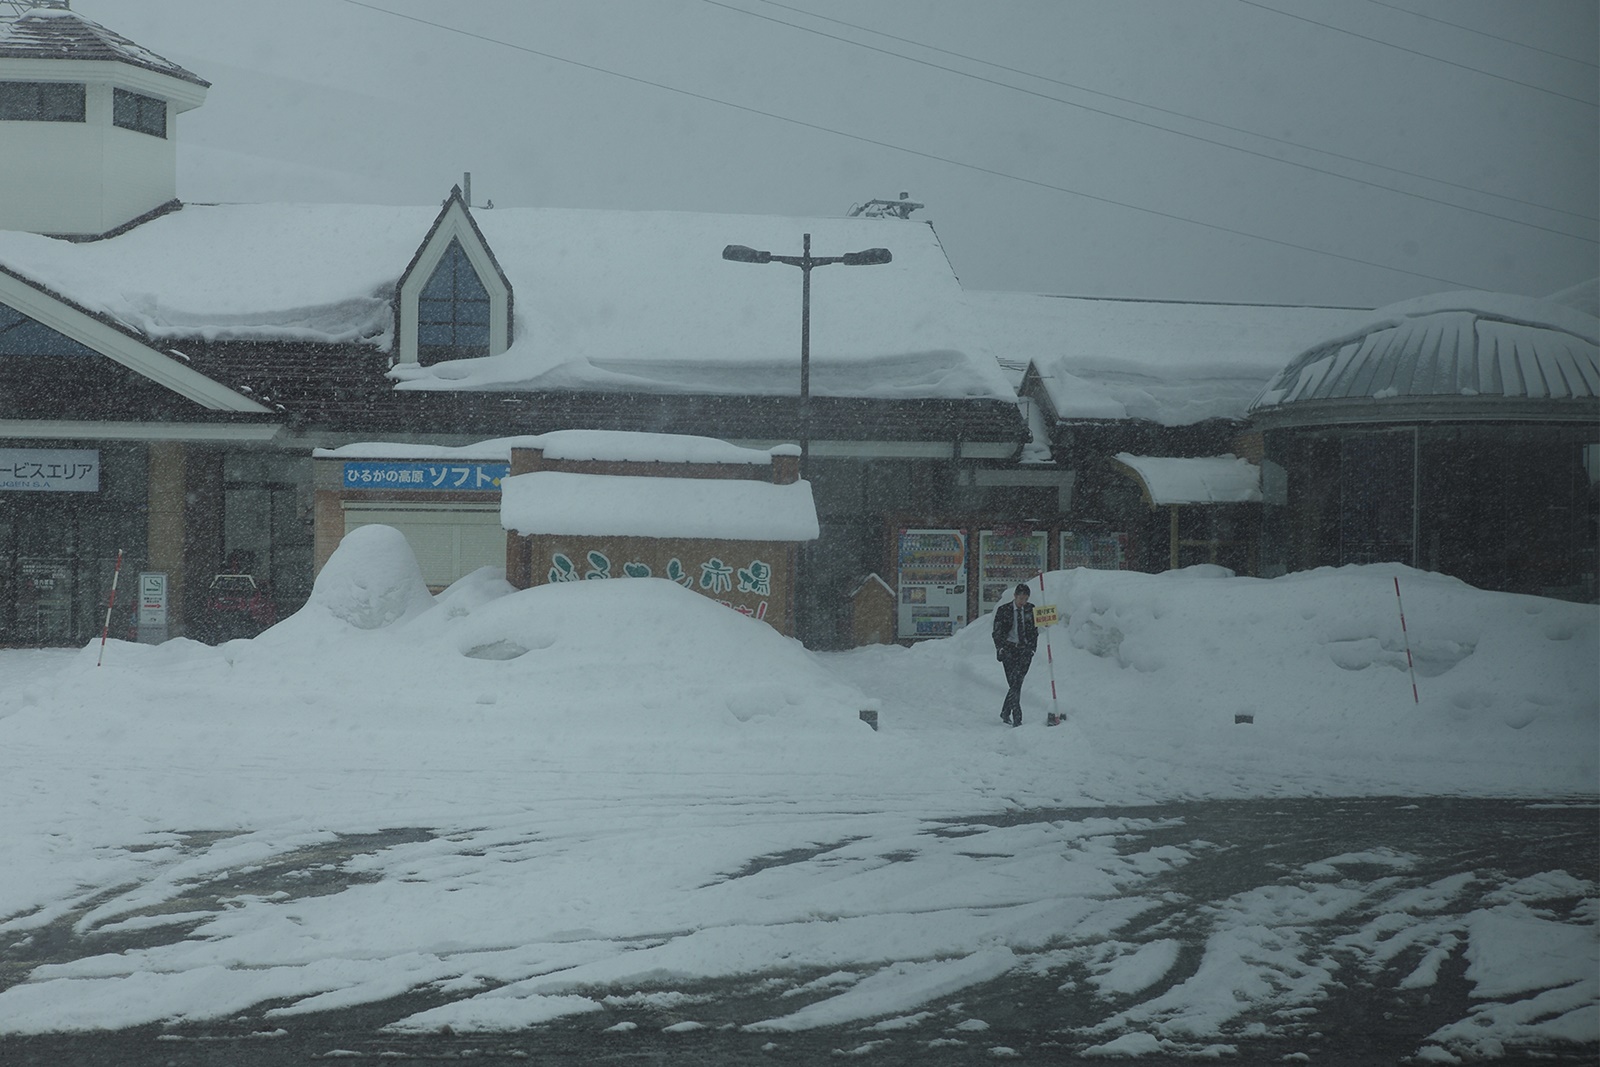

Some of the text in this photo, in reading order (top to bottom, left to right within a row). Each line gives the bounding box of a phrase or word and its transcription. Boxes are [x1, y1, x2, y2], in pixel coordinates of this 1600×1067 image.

[347, 469, 424, 483] ひるがの高原
[429, 466, 491, 488] ソフト
